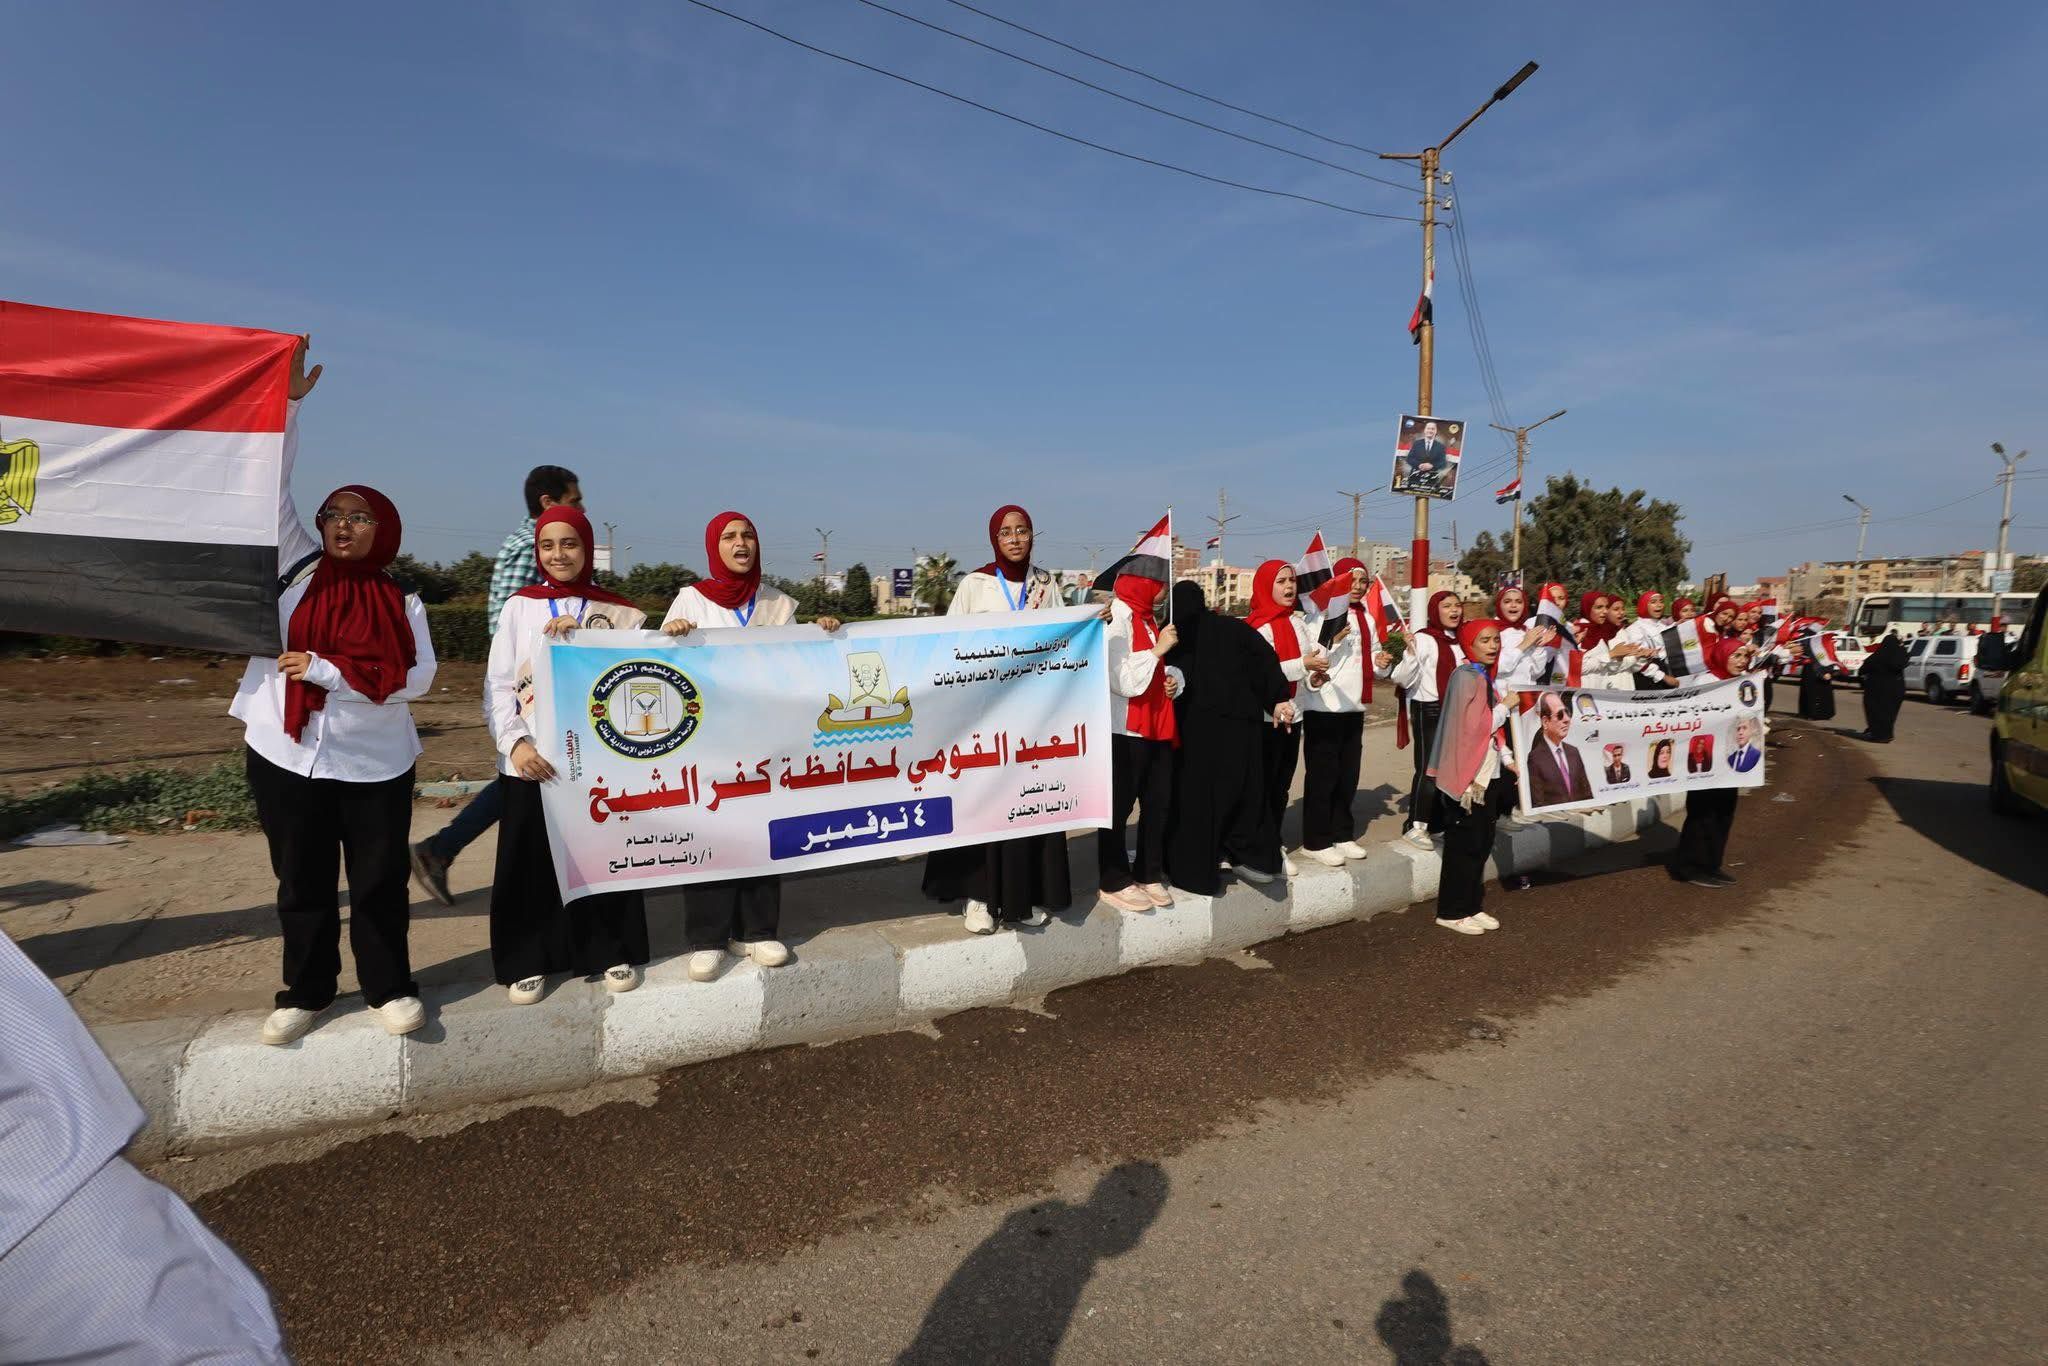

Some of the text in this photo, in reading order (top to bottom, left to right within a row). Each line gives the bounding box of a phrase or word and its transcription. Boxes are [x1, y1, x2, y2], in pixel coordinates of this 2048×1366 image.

[953, 645, 1010, 663] التعليمية
[1011, 641, 1051, 659] بلطيم
[999, 661, 1037, 683] الشرنوبي
[1037, 660, 1061, 675] صالح
[1062, 657, 1089, 672] مدرسة
[596, 664, 692, 694] إدارة بلطيم التعليمية
[933, 671, 954, 688] بنات
[599, 723, 611, 737] بنات
[679, 720, 694, 736] مدرسة
[1641, 721, 1669, 738] بكم
[637, 743, 666, 756] الشرنوبي
[667, 735, 681, 749] صالح
[588, 723, 1087, 824] العيد القومي لمحافظة كفر الشيخ
[1019, 782, 1048, 797] الفصل
[1007, 803, 1044, 823] الجندي
[800, 802, 927, 851] ٤ نوفمبر
[626, 832, 694, 848] الرائد العام
[608, 856, 656, 874] صالح
